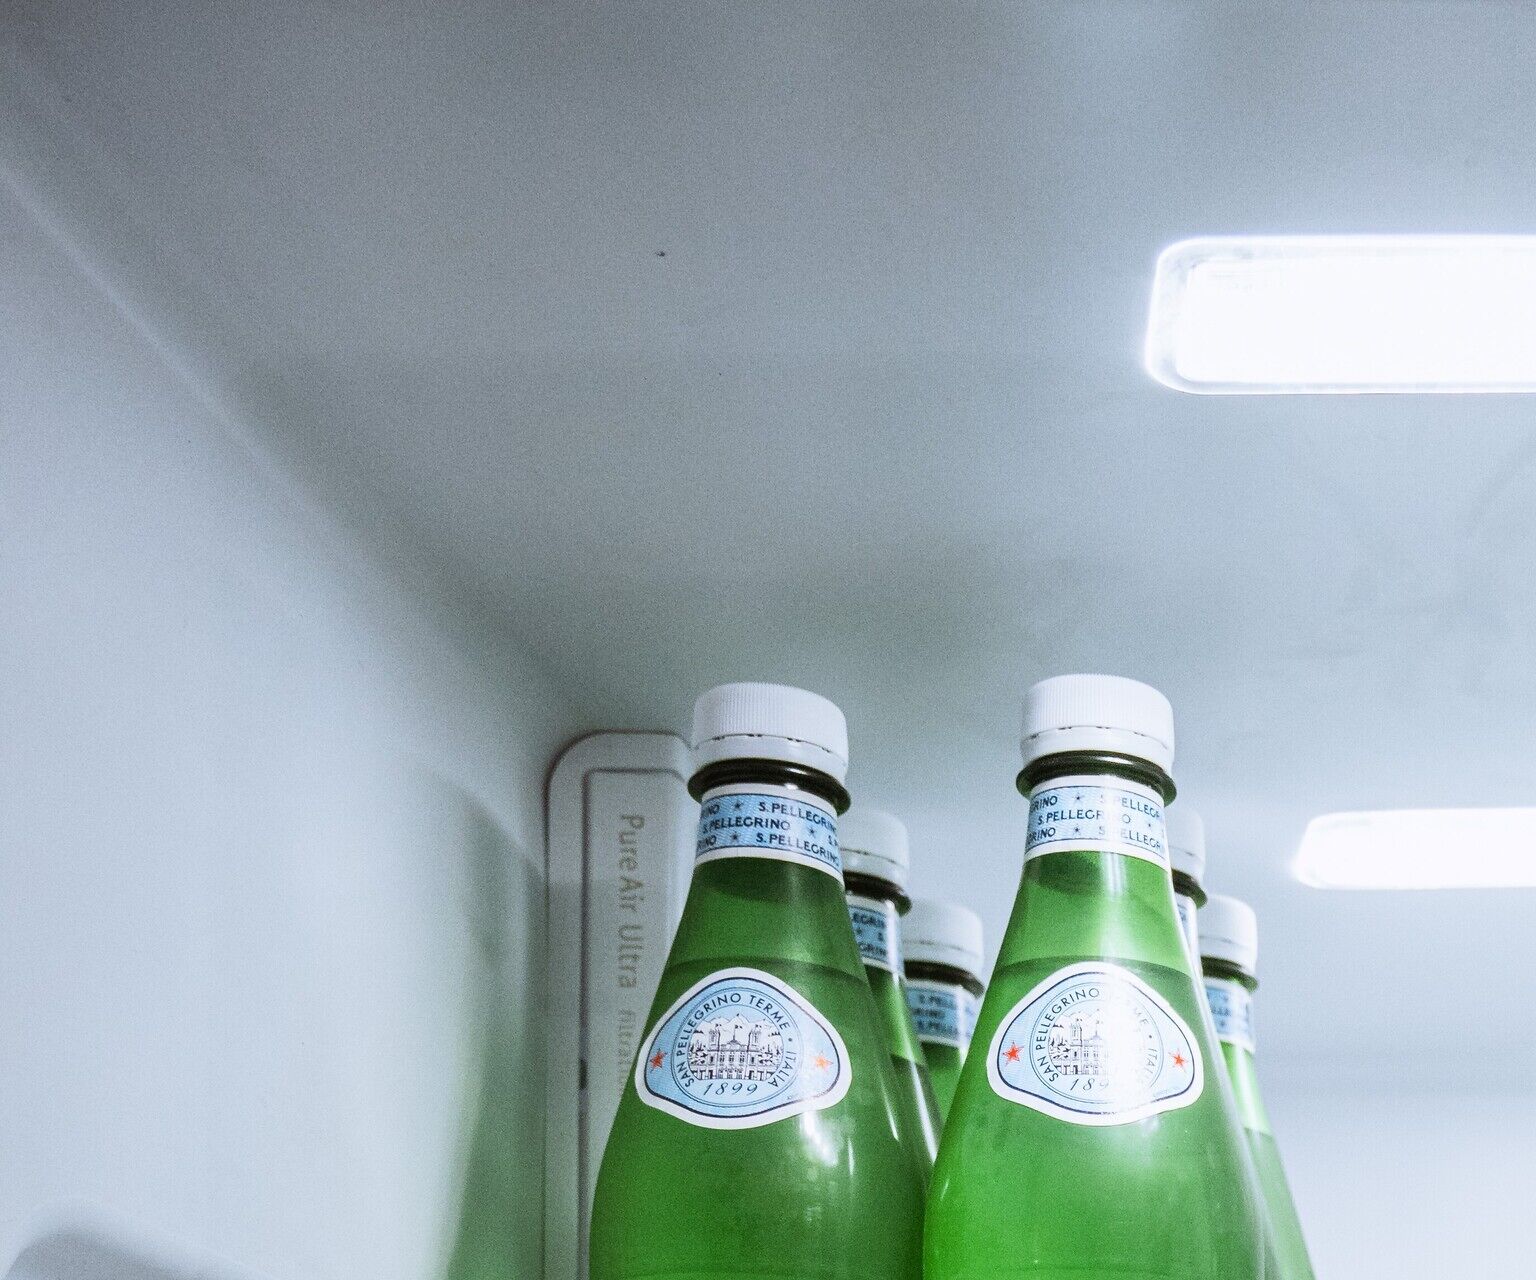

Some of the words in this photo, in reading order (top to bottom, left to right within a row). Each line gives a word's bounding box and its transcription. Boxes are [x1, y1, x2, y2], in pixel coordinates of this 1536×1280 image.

[677, 993, 741, 1057] PELLEGRINO
[749, 994, 790, 1030] TERME
[1036, 988, 1100, 1051] PELLEGRINO
[676, 1061, 695, 1088] SAN
[769, 1050, 797, 1088] ITALIA
[1037, 1058, 1059, 1082] SAN
[703, 1082, 758, 1097] 1899
